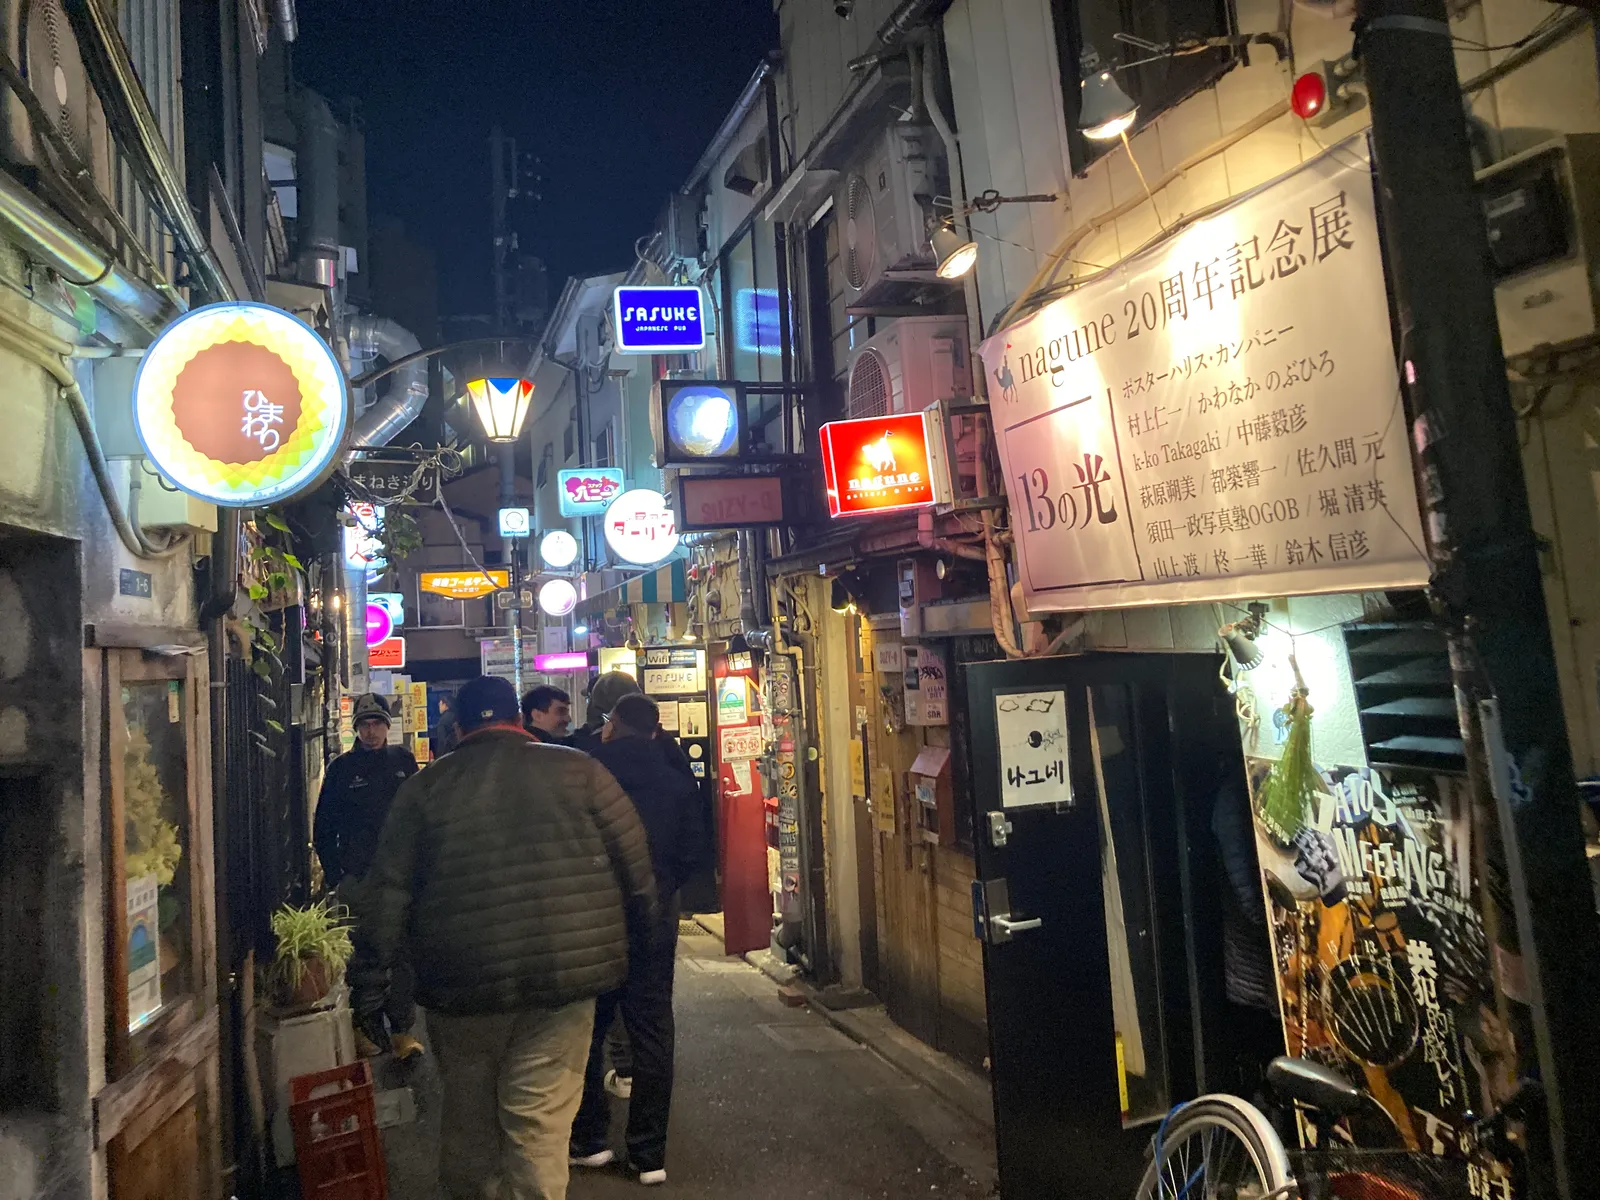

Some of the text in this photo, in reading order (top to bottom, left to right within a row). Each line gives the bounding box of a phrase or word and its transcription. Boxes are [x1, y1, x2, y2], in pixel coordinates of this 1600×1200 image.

[624, 306, 698, 321] SASUKE
[1018, 190, 1354, 387] nagune 20周年記念展
[1122, 326, 1294, 399] ポスターハリス・カンパニー
[1127, 406, 1182, 438] 村上仁一
[1266, 350, 1335, 392] のぶひろ
[1133, 453, 1159, 471] k-ko
[1161, 431, 1221, 464] Takagaki
[1237, 404, 1308, 446] 中藤毅彦
[1018, 453, 1117, 532] 13の光
[648, 655, 668, 663] Wifi
[649, 673, 692, 683] SASUKE
[1007, 760, 1064, 788] 나그네
